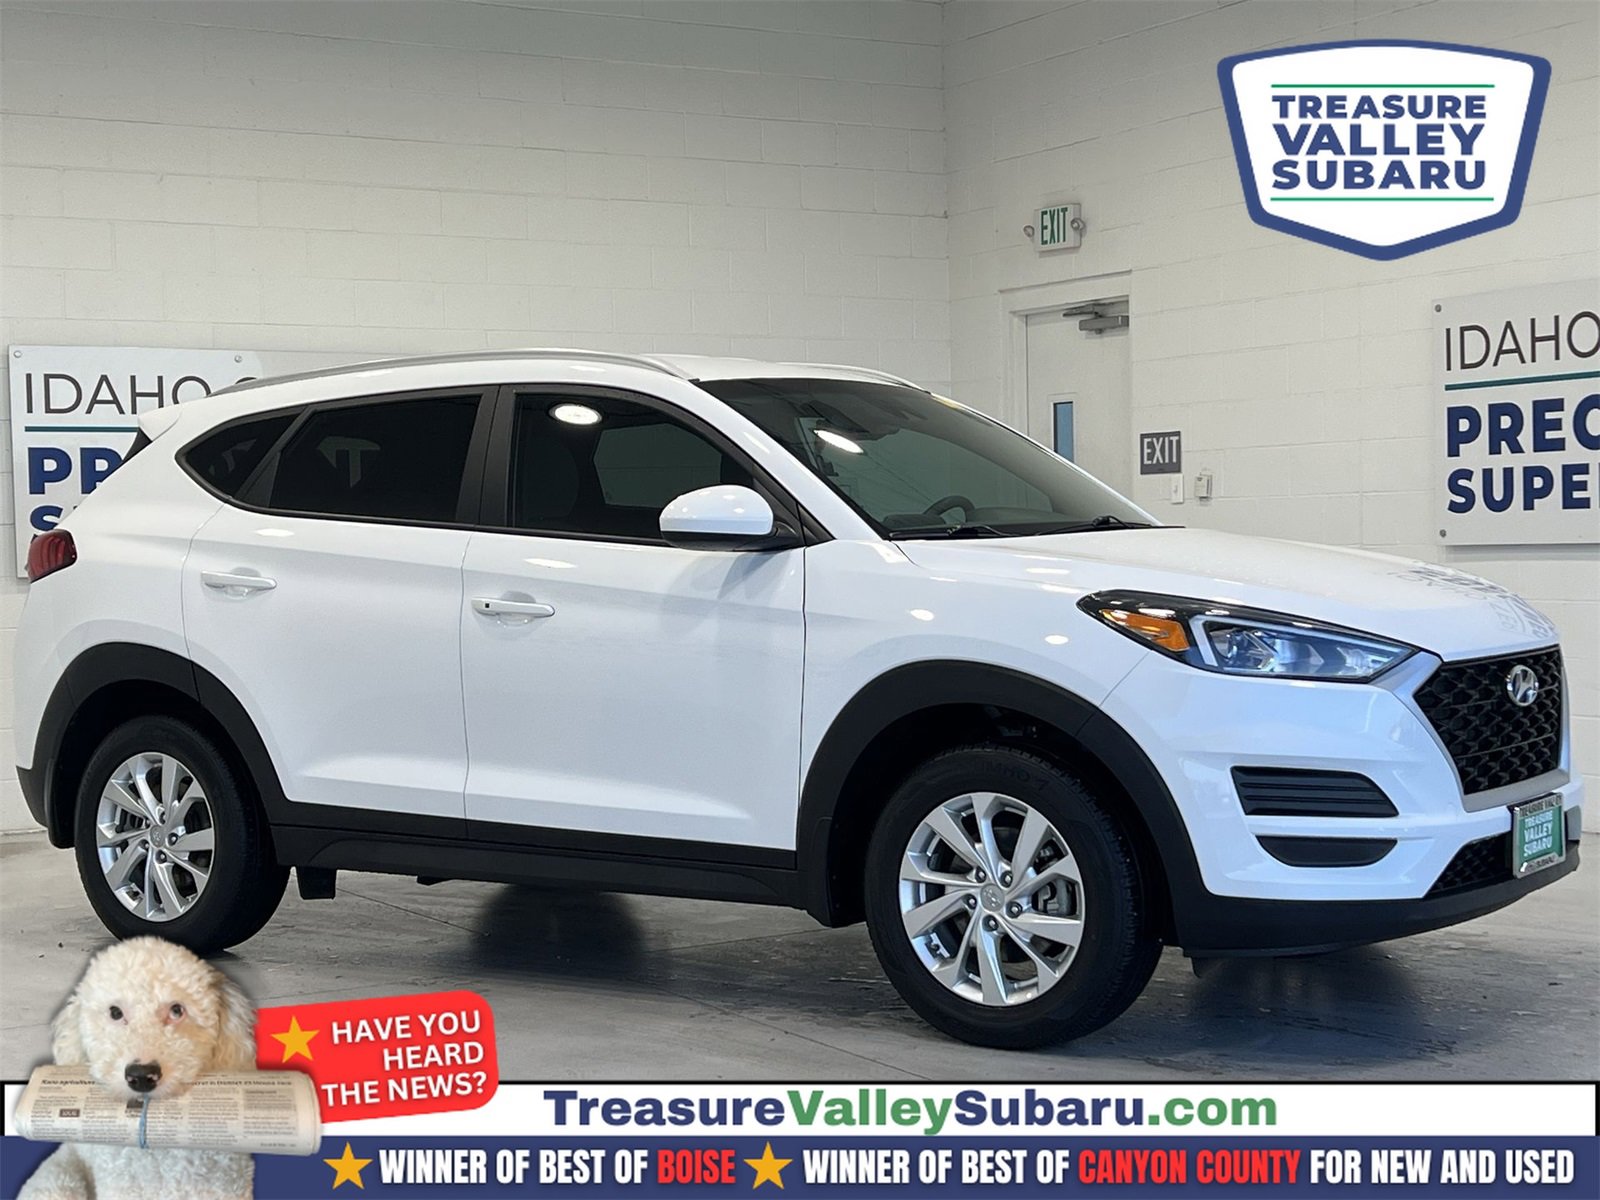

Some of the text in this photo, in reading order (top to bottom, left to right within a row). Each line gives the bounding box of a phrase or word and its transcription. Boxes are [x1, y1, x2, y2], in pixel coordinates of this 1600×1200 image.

[1040, 207, 1069, 246] EXIT
[1445, 311, 1600, 371] IDAHO
[25, 372, 212, 415] IDAHO
[1143, 436, 1180, 466] EXIT
[1447, 463, 1600, 514] SUPE
[1523, 836, 1553, 857] SUBARU
[1524, 822, 1553, 843] VALLEY
